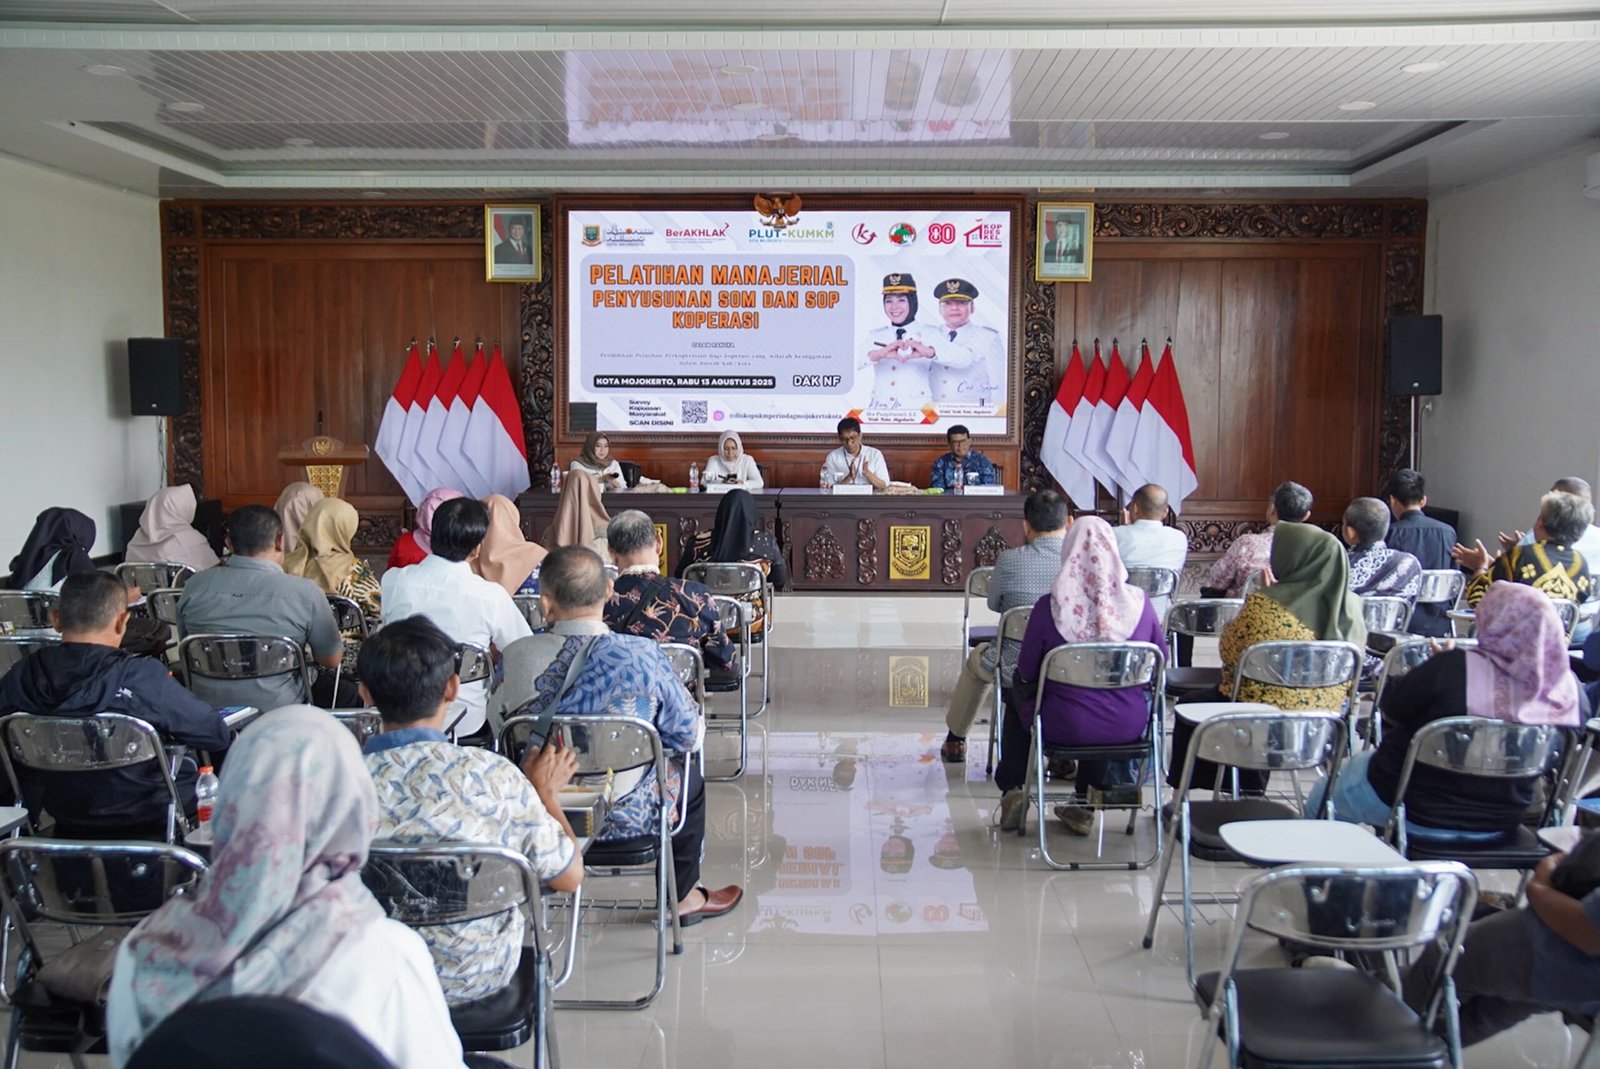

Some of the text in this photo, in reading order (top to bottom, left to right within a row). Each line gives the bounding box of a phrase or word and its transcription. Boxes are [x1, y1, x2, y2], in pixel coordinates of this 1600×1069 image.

[665, 228, 726, 237] BerAKHLAK
[749, 229, 835, 239] PLUT-KUMKM
[928, 223, 955, 244] 80
[590, 264, 848, 286] PELATIHAN MANAJERIAL
[593, 290, 840, 309] PENYUSUNAN SOM DAN SOP
[672, 311, 759, 329] KOPERASI
[596, 377, 620, 385] KOTA
[621, 378, 676, 386] MOJOKERTO,
[793, 375, 841, 386] DAK NF
